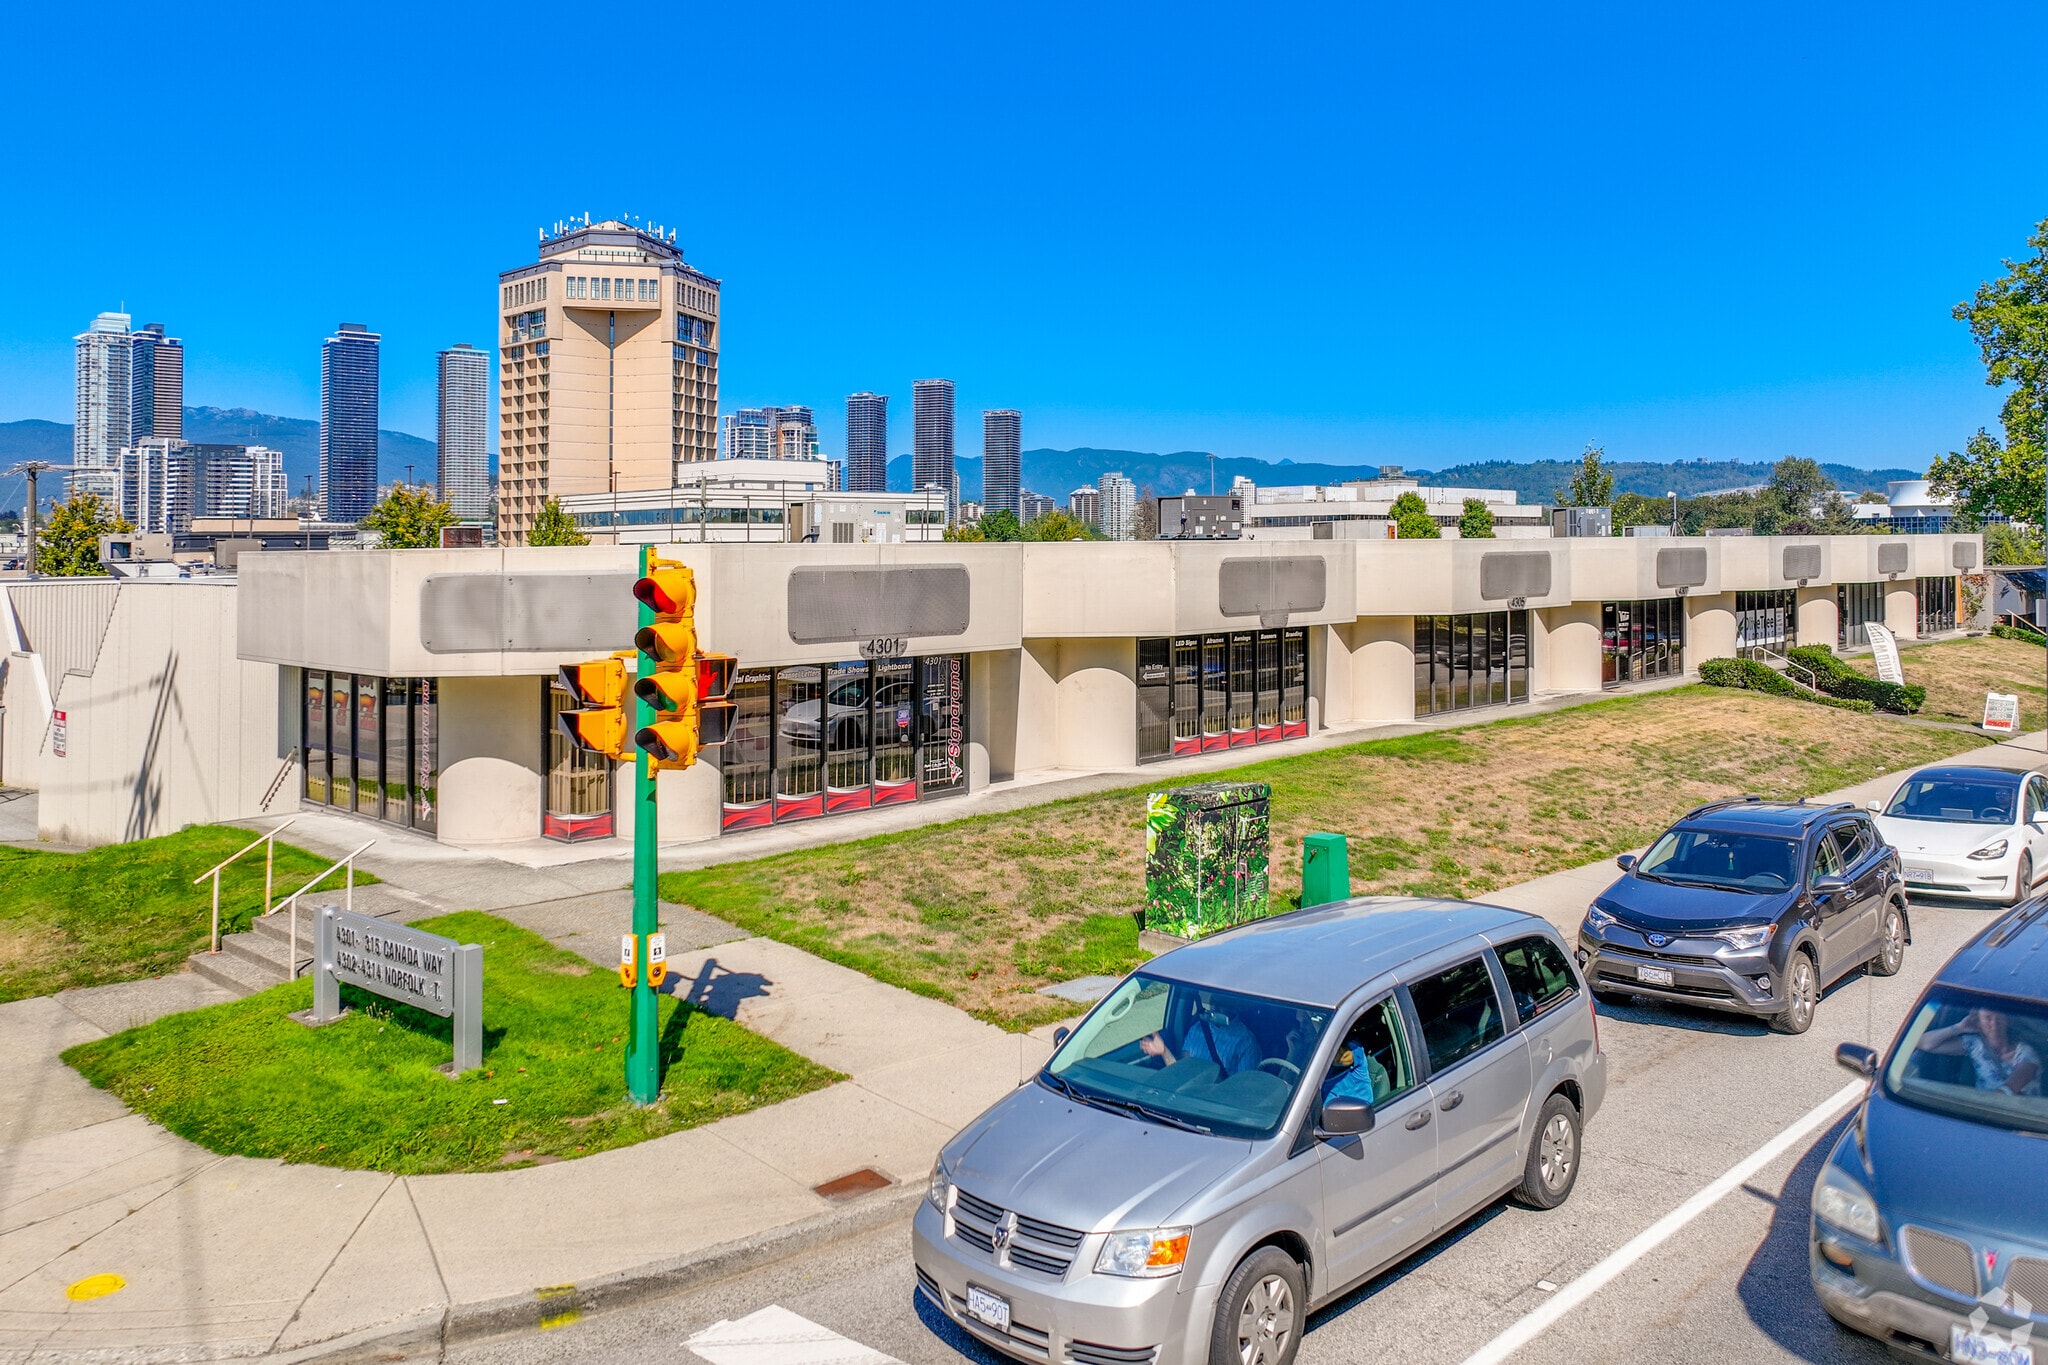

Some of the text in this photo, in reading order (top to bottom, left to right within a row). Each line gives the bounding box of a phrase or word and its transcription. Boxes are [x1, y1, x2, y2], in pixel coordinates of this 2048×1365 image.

[1511, 596, 1526, 607] 4305
[866, 637, 900, 655] 4301
[924, 656, 942, 666] 4301
[827, 665, 870, 676] Trade Shows
[877, 662, 912, 673] Lightboxes
[744, 673, 772, 684] Graphics
[777, 668, 821, 680] Channel Letters
[948, 659, 963, 758] Signarama
[419, 679, 431, 791] Signarama
[364, 934, 382, 957] 315
[383, 940, 421, 970] CANADA
[422, 951, 443, 977] WAY
[384, 966, 426, 998] NORFOLK
